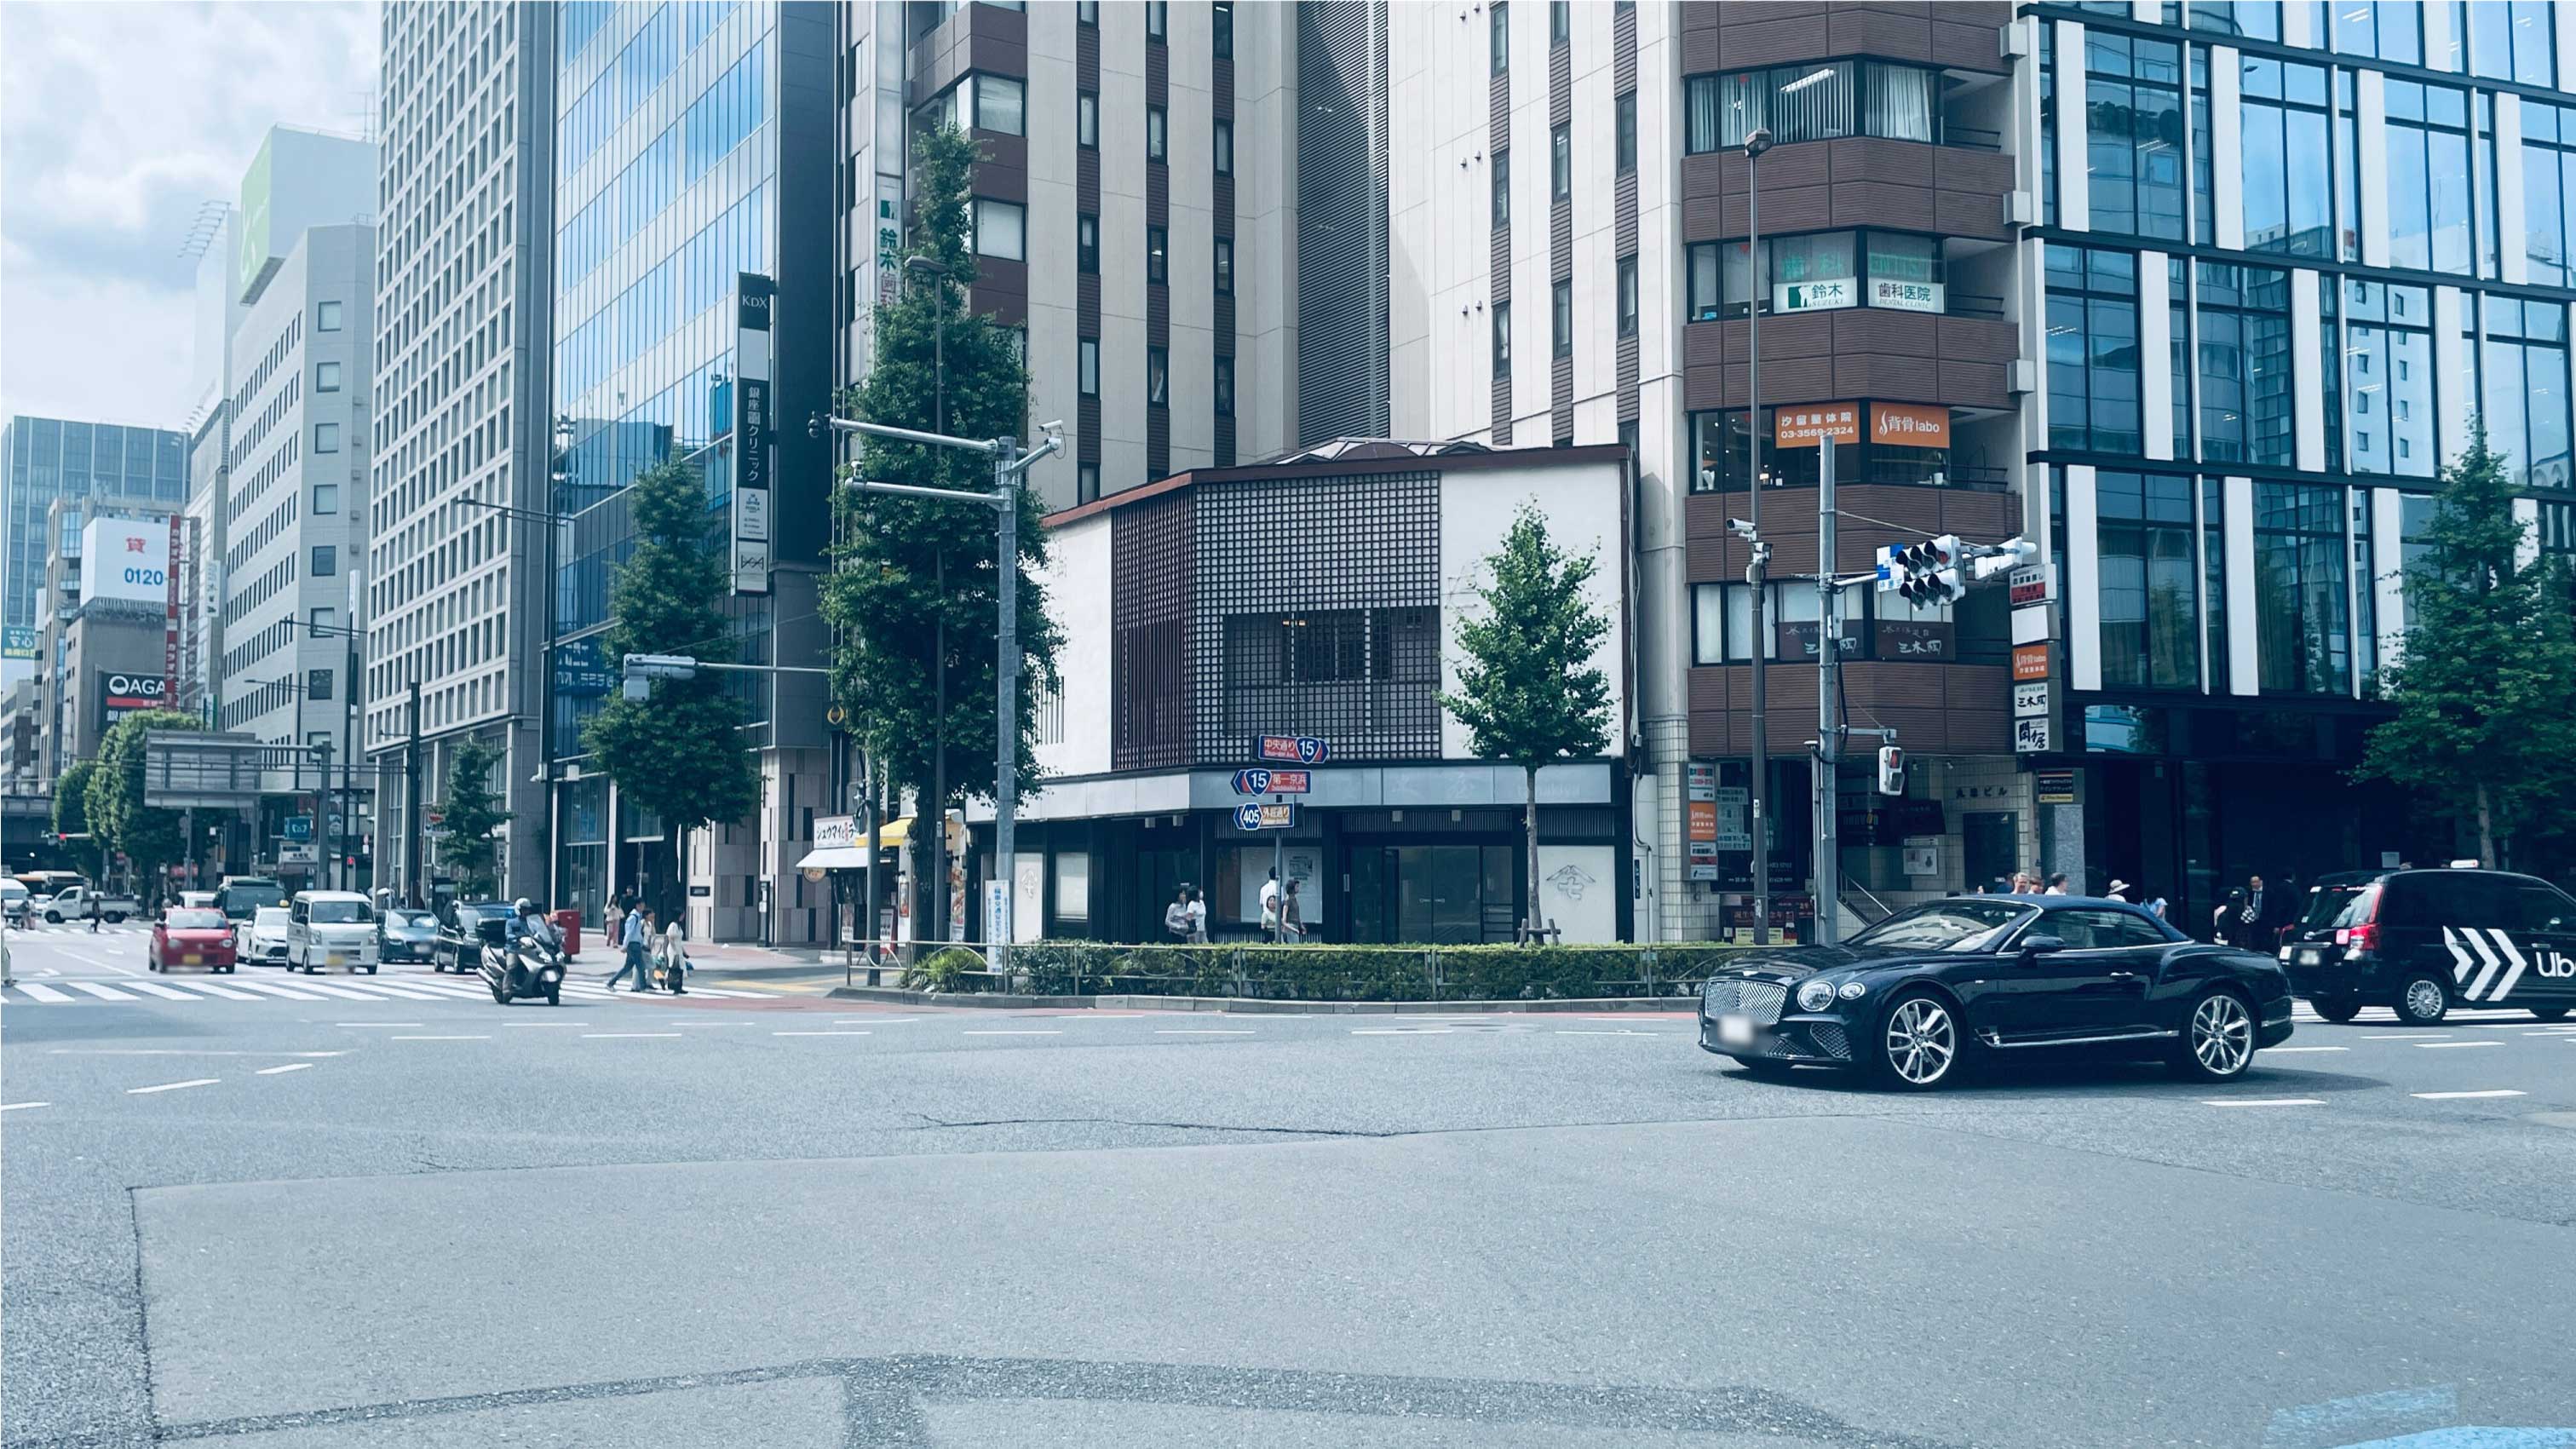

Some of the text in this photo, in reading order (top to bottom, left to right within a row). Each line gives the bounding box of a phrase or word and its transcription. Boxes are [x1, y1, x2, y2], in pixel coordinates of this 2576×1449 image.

[1812, 283, 1843, 299] 鈴木
[1878, 283, 1931, 302] 歯科医院
[742, 295, 768, 308] KDX
[1810, 298, 1844, 308] SUZUKI
[1879, 298, 1905, 308] DENTAL
[1264, 739, 1295, 751] 中央通り
[1300, 740, 1314, 756] 15
[1251, 773, 1268, 789] 15
[1273, 773, 1307, 785] 第一京浜
[1243, 809, 1260, 824] 405
[2535, 952, 2576, 978] Ub
